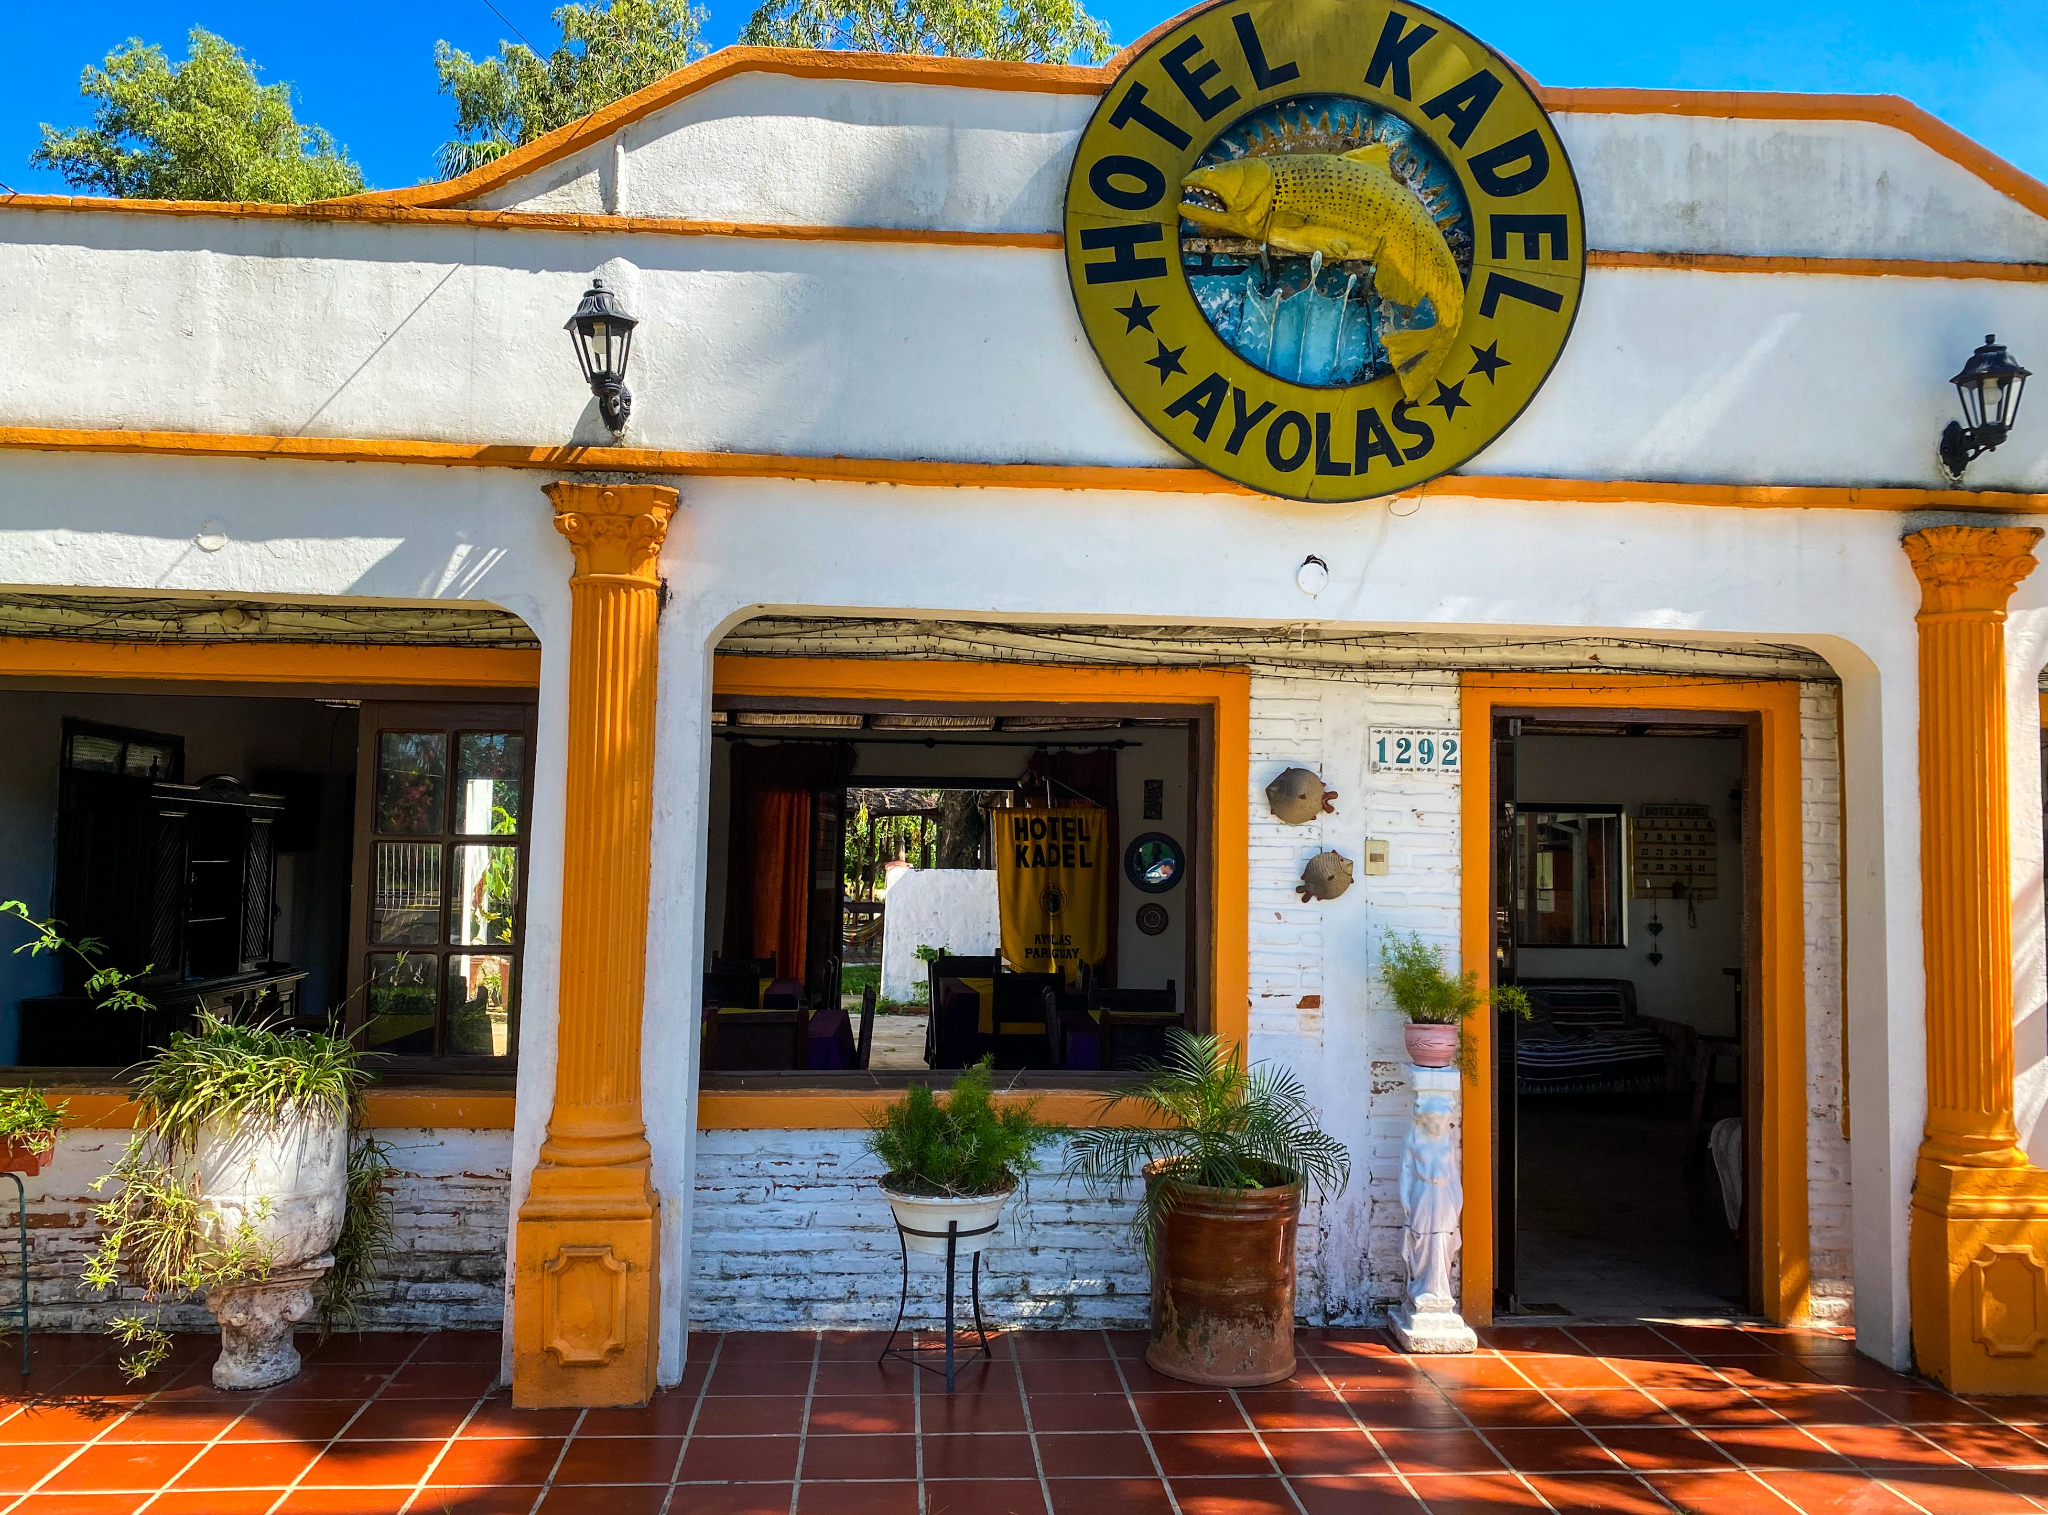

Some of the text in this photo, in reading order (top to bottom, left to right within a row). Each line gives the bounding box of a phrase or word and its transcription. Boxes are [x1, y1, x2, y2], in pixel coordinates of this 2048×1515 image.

[1080, 10, 1570, 320] HOTEL KADEL
[1163, 371, 1436, 478] AYOLAS
[1376, 736, 1458, 766] 1292
[1645, 806, 1675, 816] HOTEL
[1013, 816, 1091, 842] HOTEL
[1671, 833, 1676, 841] 9
[1684, 833, 1692, 841] 10
[1015, 844, 1093, 869] KADEL
